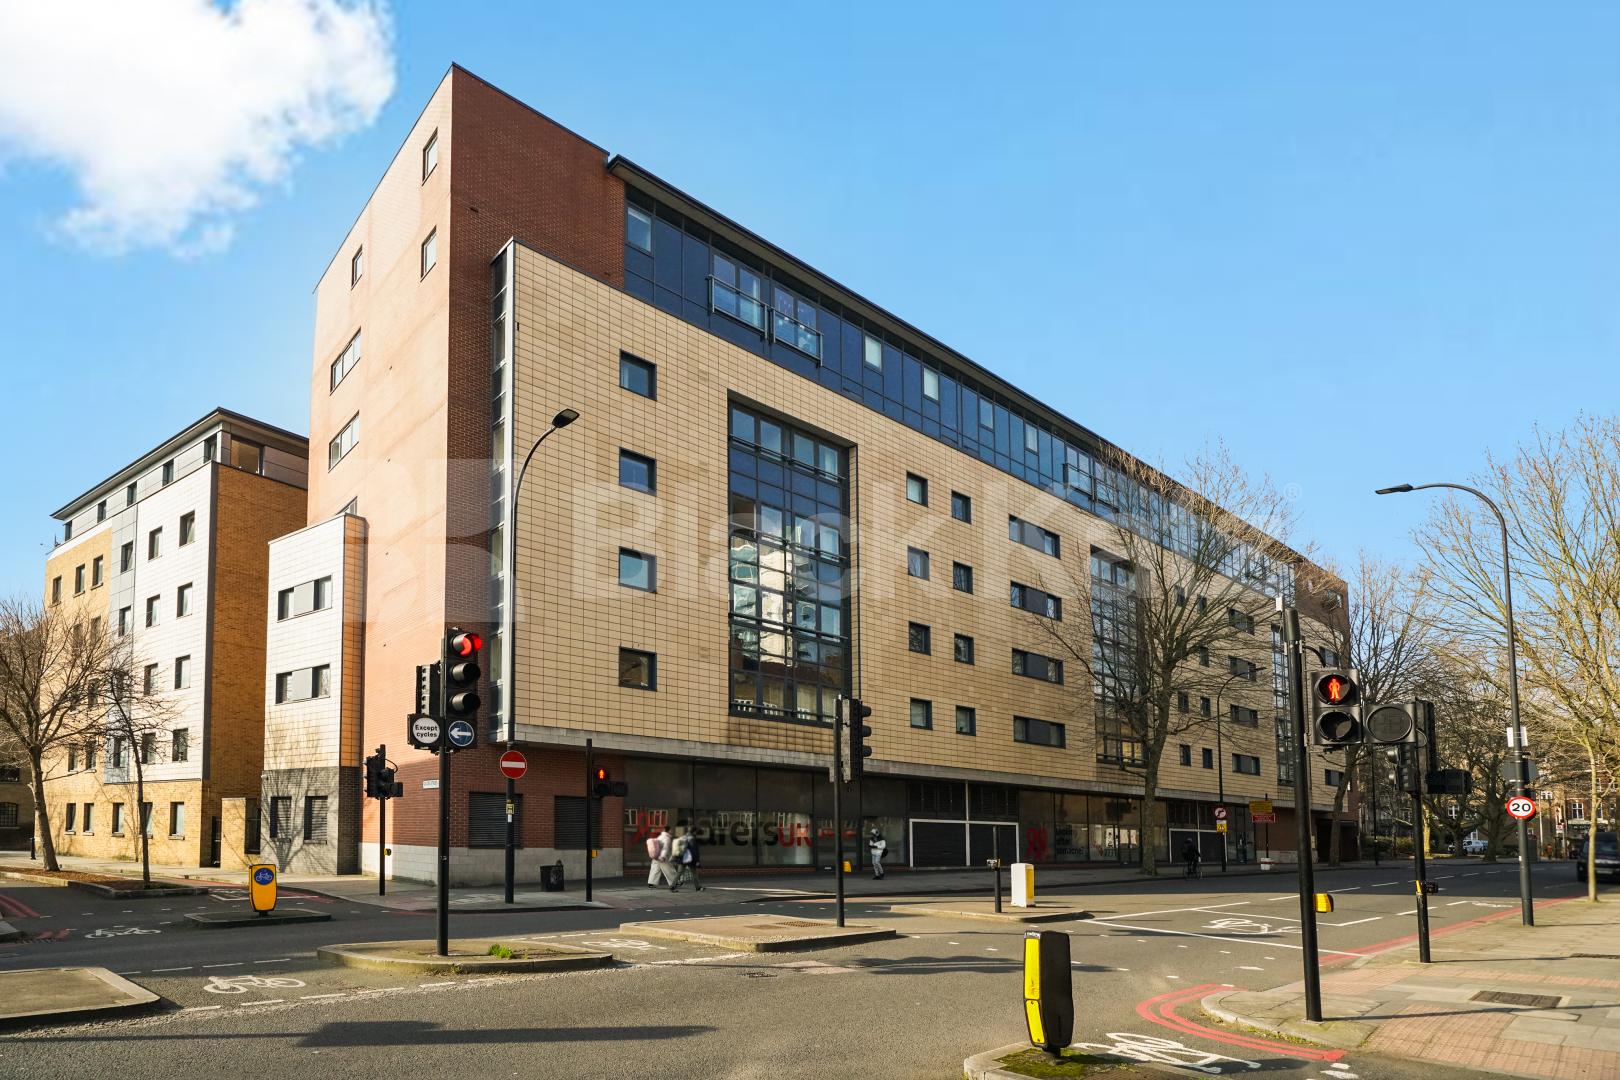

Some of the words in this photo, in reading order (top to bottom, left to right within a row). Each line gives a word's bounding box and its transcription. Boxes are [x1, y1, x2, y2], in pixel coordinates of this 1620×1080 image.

[415, 724, 438, 732] Except
[416, 731, 438, 739] cycles
[1511, 802, 1531, 813] 20
